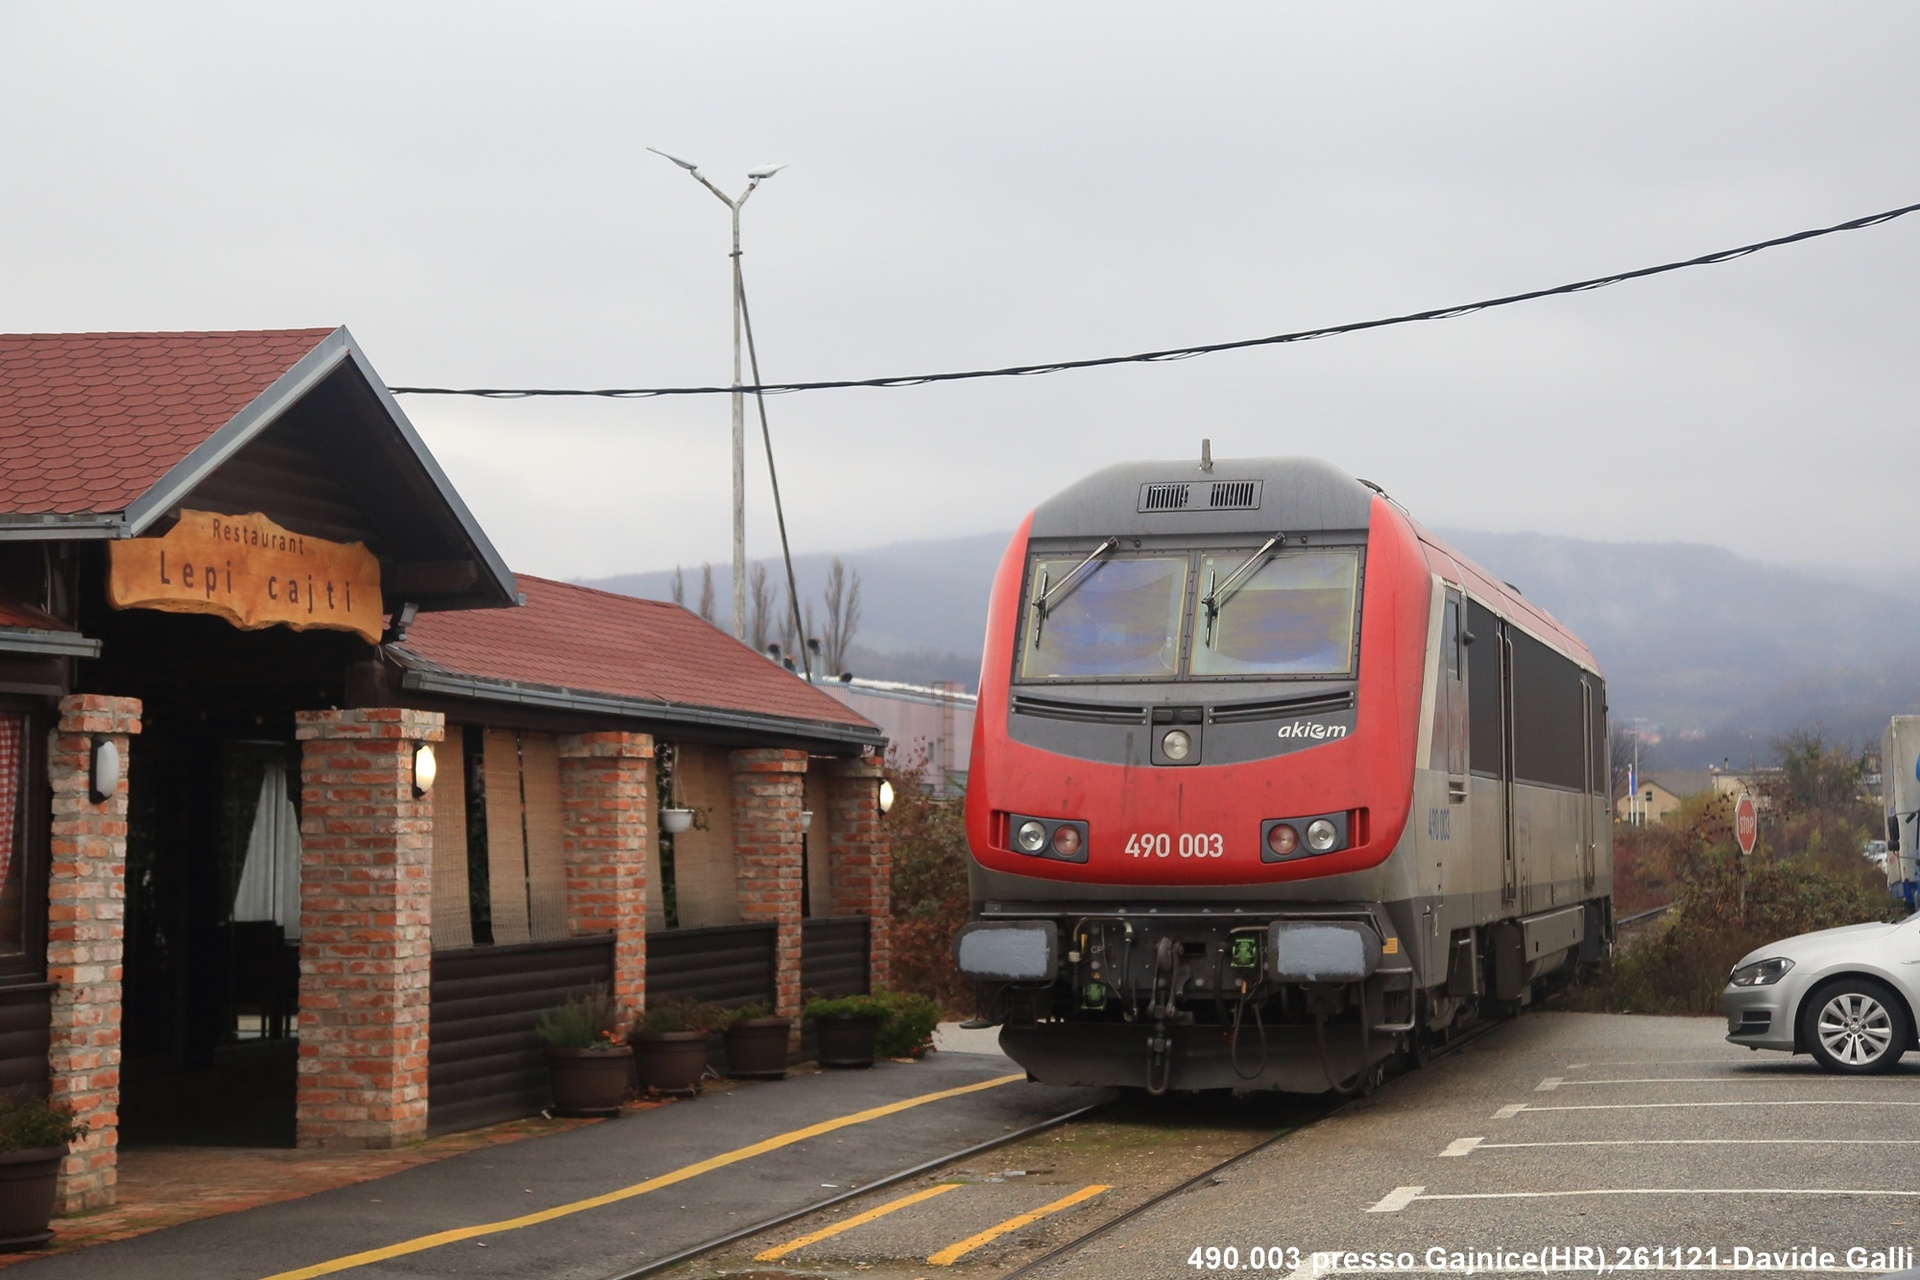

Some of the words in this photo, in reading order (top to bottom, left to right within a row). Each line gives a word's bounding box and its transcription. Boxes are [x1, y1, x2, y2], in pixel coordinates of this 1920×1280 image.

[212, 518, 304, 555] Restaurant
[160, 551, 232, 598] Lepi
[268, 574, 351, 613] cajti
[1277, 721, 1347, 740] akiem
[1428, 808, 1439, 841] 490
[1440, 808, 1450, 841] 003
[1740, 816, 1754, 835] STOP
[1124, 833, 1171, 858] 490
[1179, 833, 1223, 858] 003
